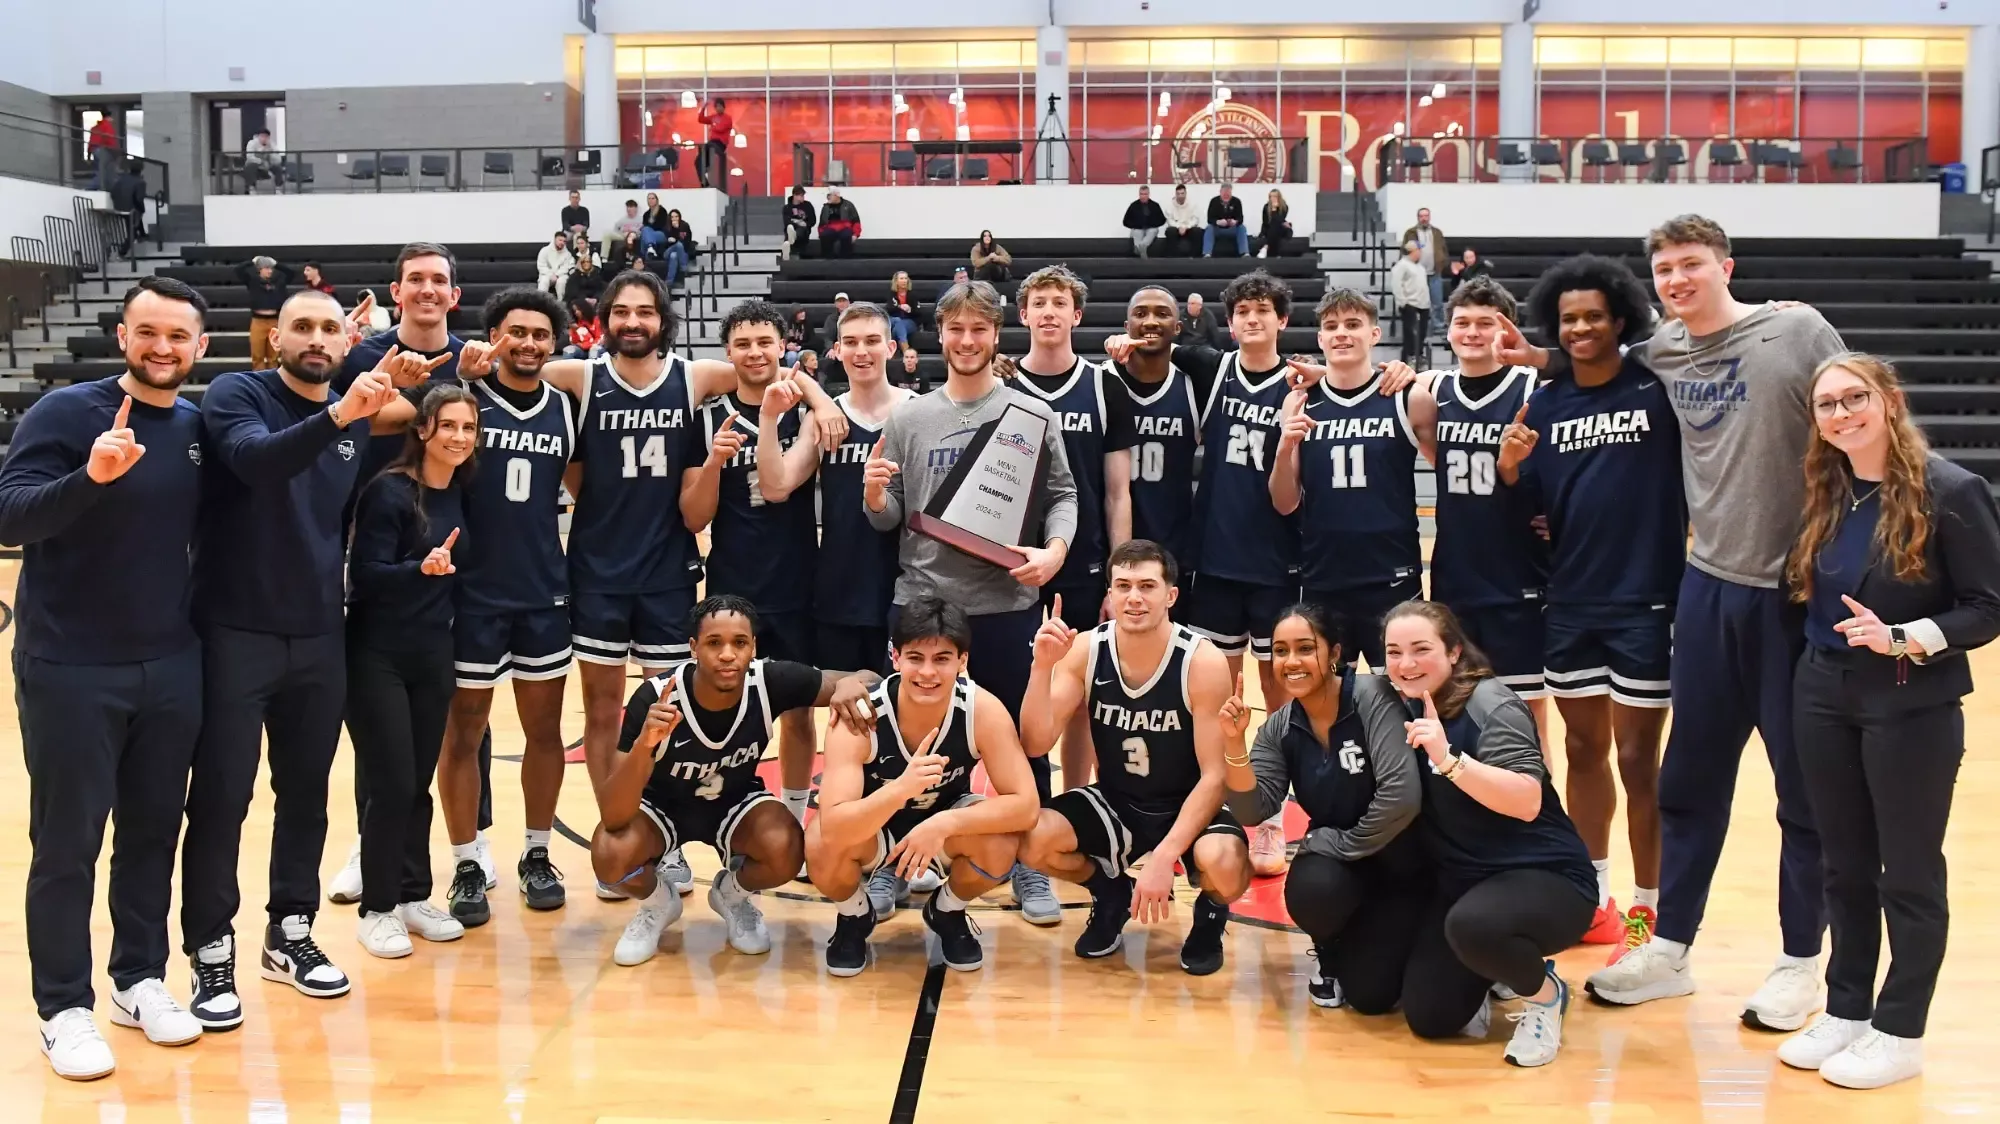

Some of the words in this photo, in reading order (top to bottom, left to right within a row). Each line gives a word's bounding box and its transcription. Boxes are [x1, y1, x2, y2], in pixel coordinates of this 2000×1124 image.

[1674, 380, 1747, 402] ITHACA
[600, 408, 684, 431] ITHACA
[1134, 415, 1183, 437] ACA
[1550, 409, 1651, 445] ITHACA
[480, 427, 563, 457] THACA
[1436, 421, 1502, 445] ITHAC
[1559, 432, 1641, 453] BASKETBALL
[620, 435, 668, 478] 14
[927, 447, 965, 467] ITH
[996, 459, 1017, 473] MEN'S
[1330, 444, 1367, 489] 11
[505, 457, 532, 502] 0
[983, 464, 1021, 486] BASKETBALL
[1446, 449, 1496, 495] 20
[978, 483, 1014, 503] CHAMPION
[975, 503, 1002, 520] 2024-25
[1094, 700, 1182, 732] ITHACA
[1122, 736, 1150, 777] 3
